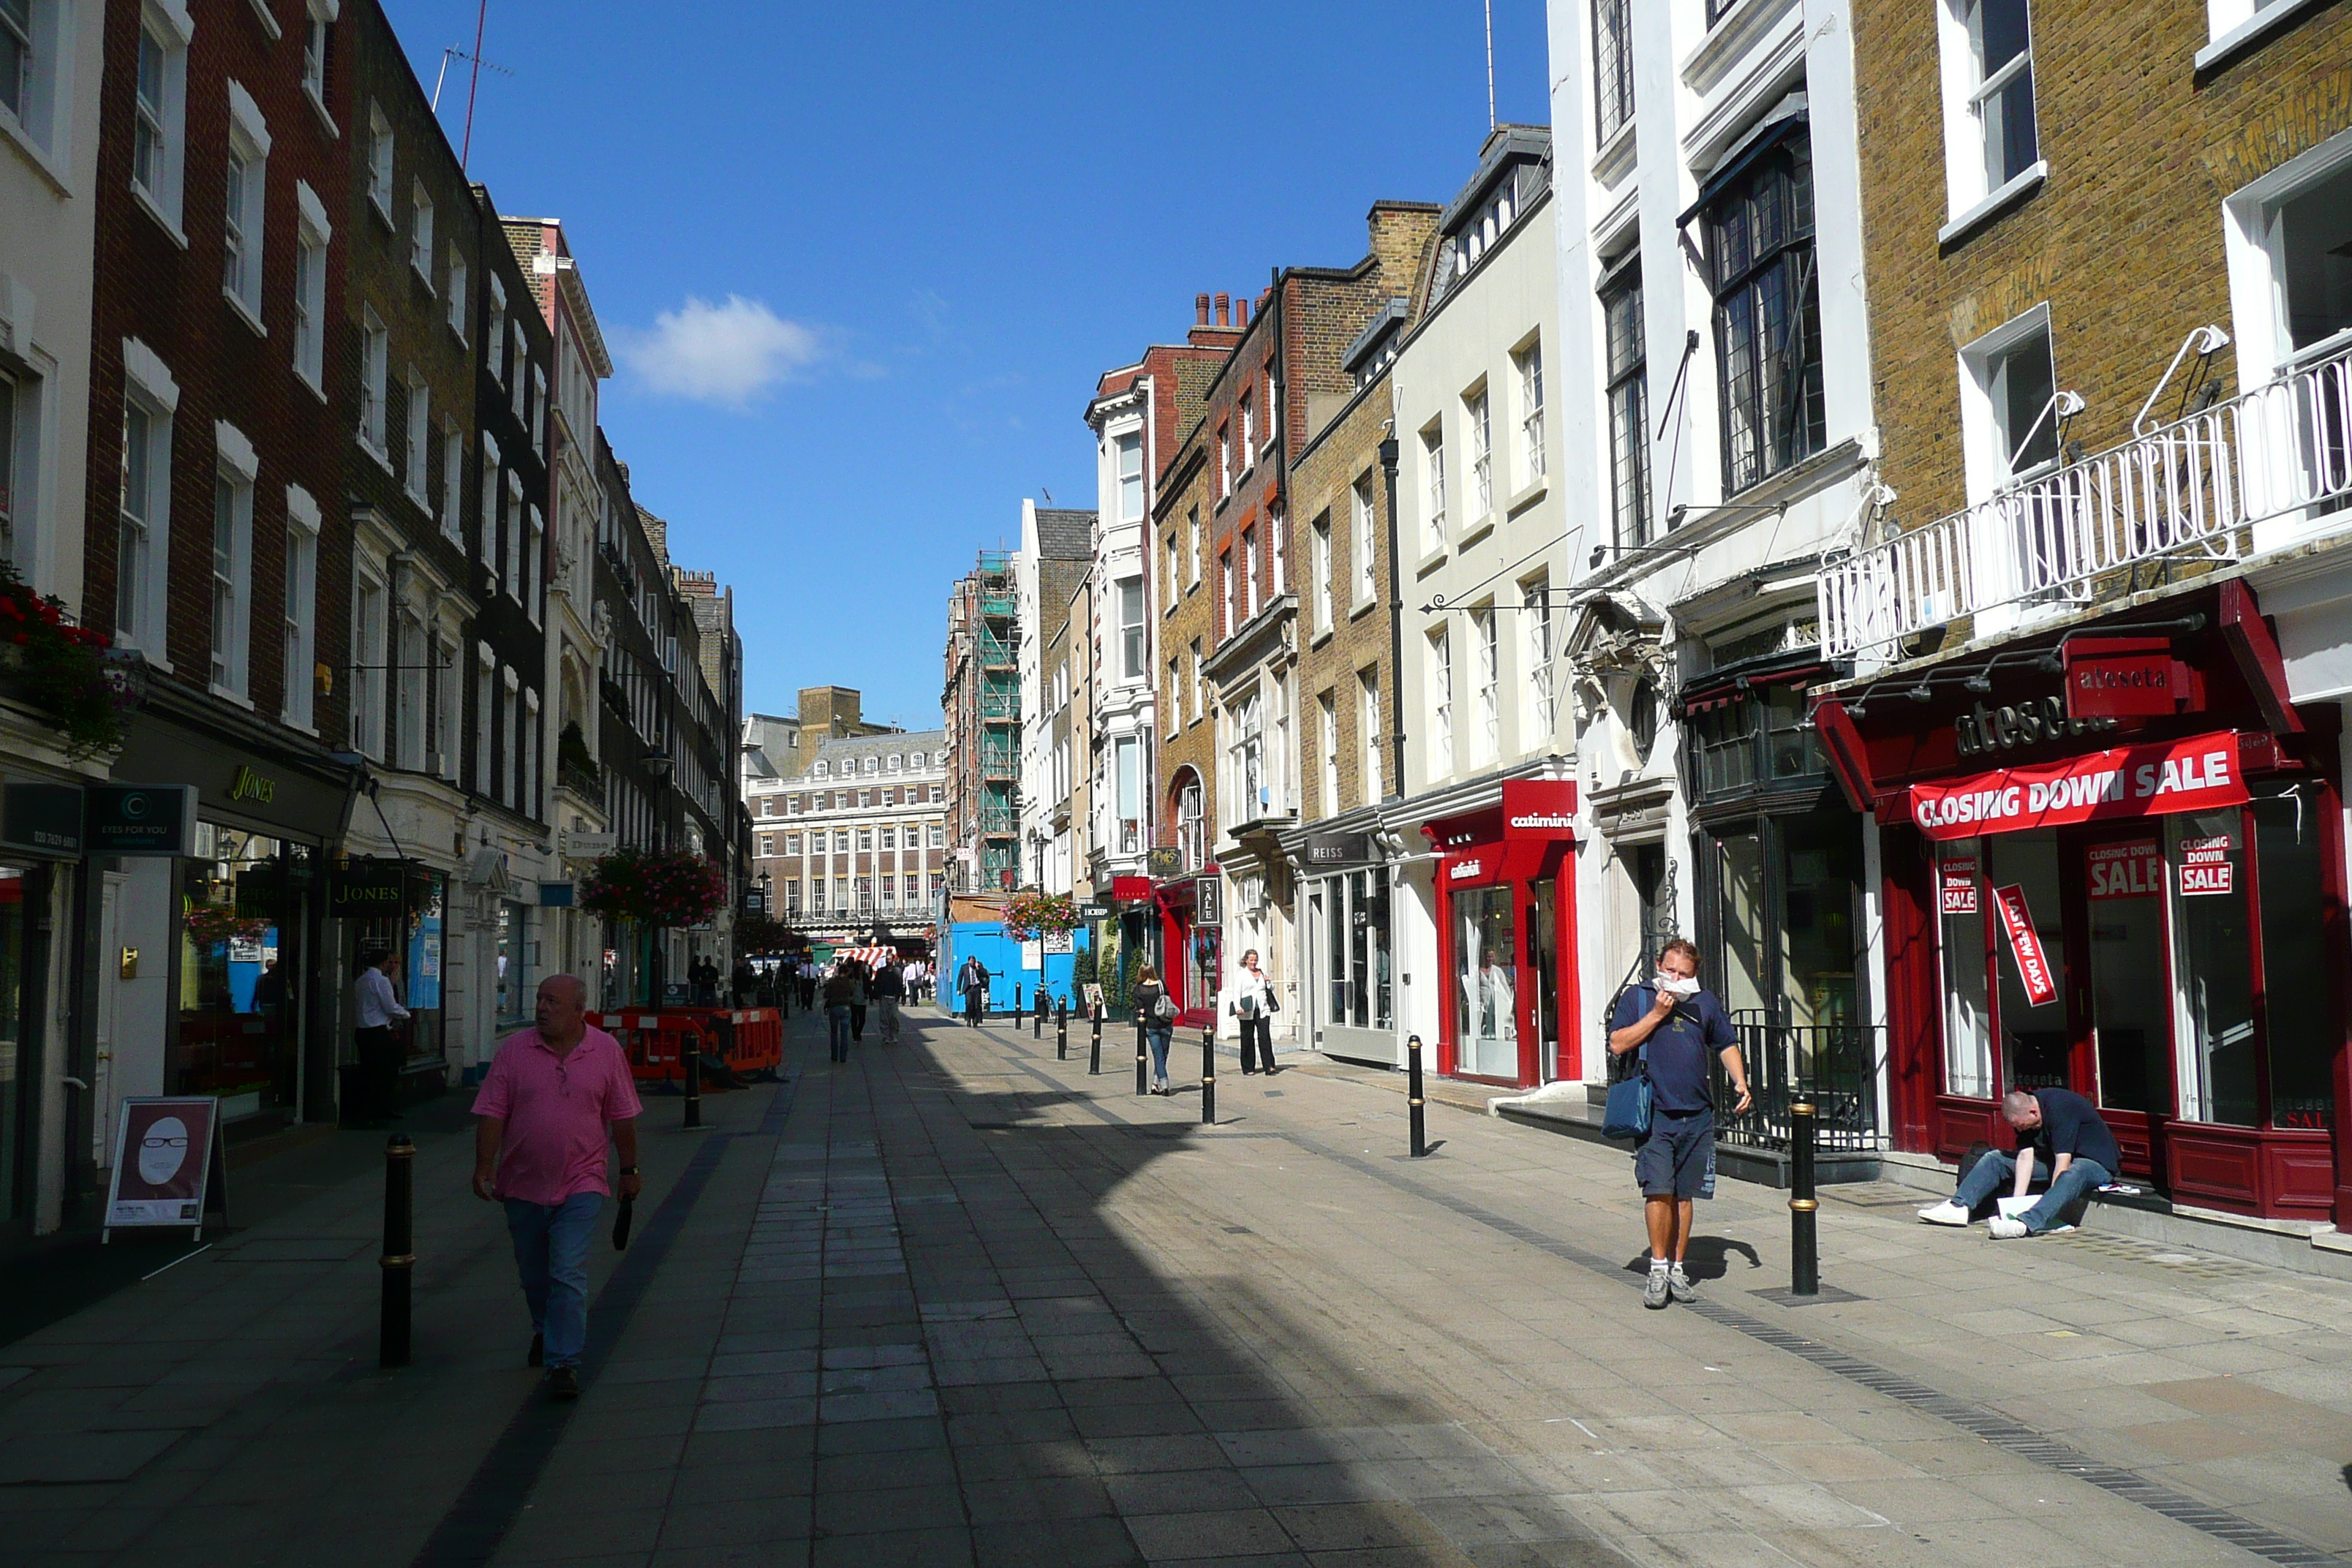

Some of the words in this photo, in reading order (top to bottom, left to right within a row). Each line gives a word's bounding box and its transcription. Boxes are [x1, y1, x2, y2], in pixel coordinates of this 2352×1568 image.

[2078, 664, 2168, 690] ateseta
[233, 765, 276, 804] JONES
[1916, 785, 2021, 829] CLOSING
[2028, 769, 2125, 815] DOWN
[2136, 750, 2231, 798] SALE
[1511, 812, 1573, 827] catimini
[102, 826, 123, 834] EYES
[125, 826, 144, 834] FOR
[146, 826, 167, 834] YOU
[572, 840, 608, 849] Dune
[2180, 836, 2228, 851] CLOSING
[1313, 847, 1343, 859] REISS
[2089, 847, 2127, 862] CLOSING
[2187, 851, 2225, 864] DOWN
[1942, 862, 1975, 872] CLOSING
[1946, 878, 1972, 887] DOWN
[2184, 867, 2229, 889] SALE
[335, 883, 399, 904] JONES
[1204, 883, 1213, 919] SALE
[1945, 892, 1975, 908] SALE
[2005, 896, 2027, 929] LAST
[2015, 929, 2035, 957] FEW
[2025, 959, 2048, 995] DAYS
